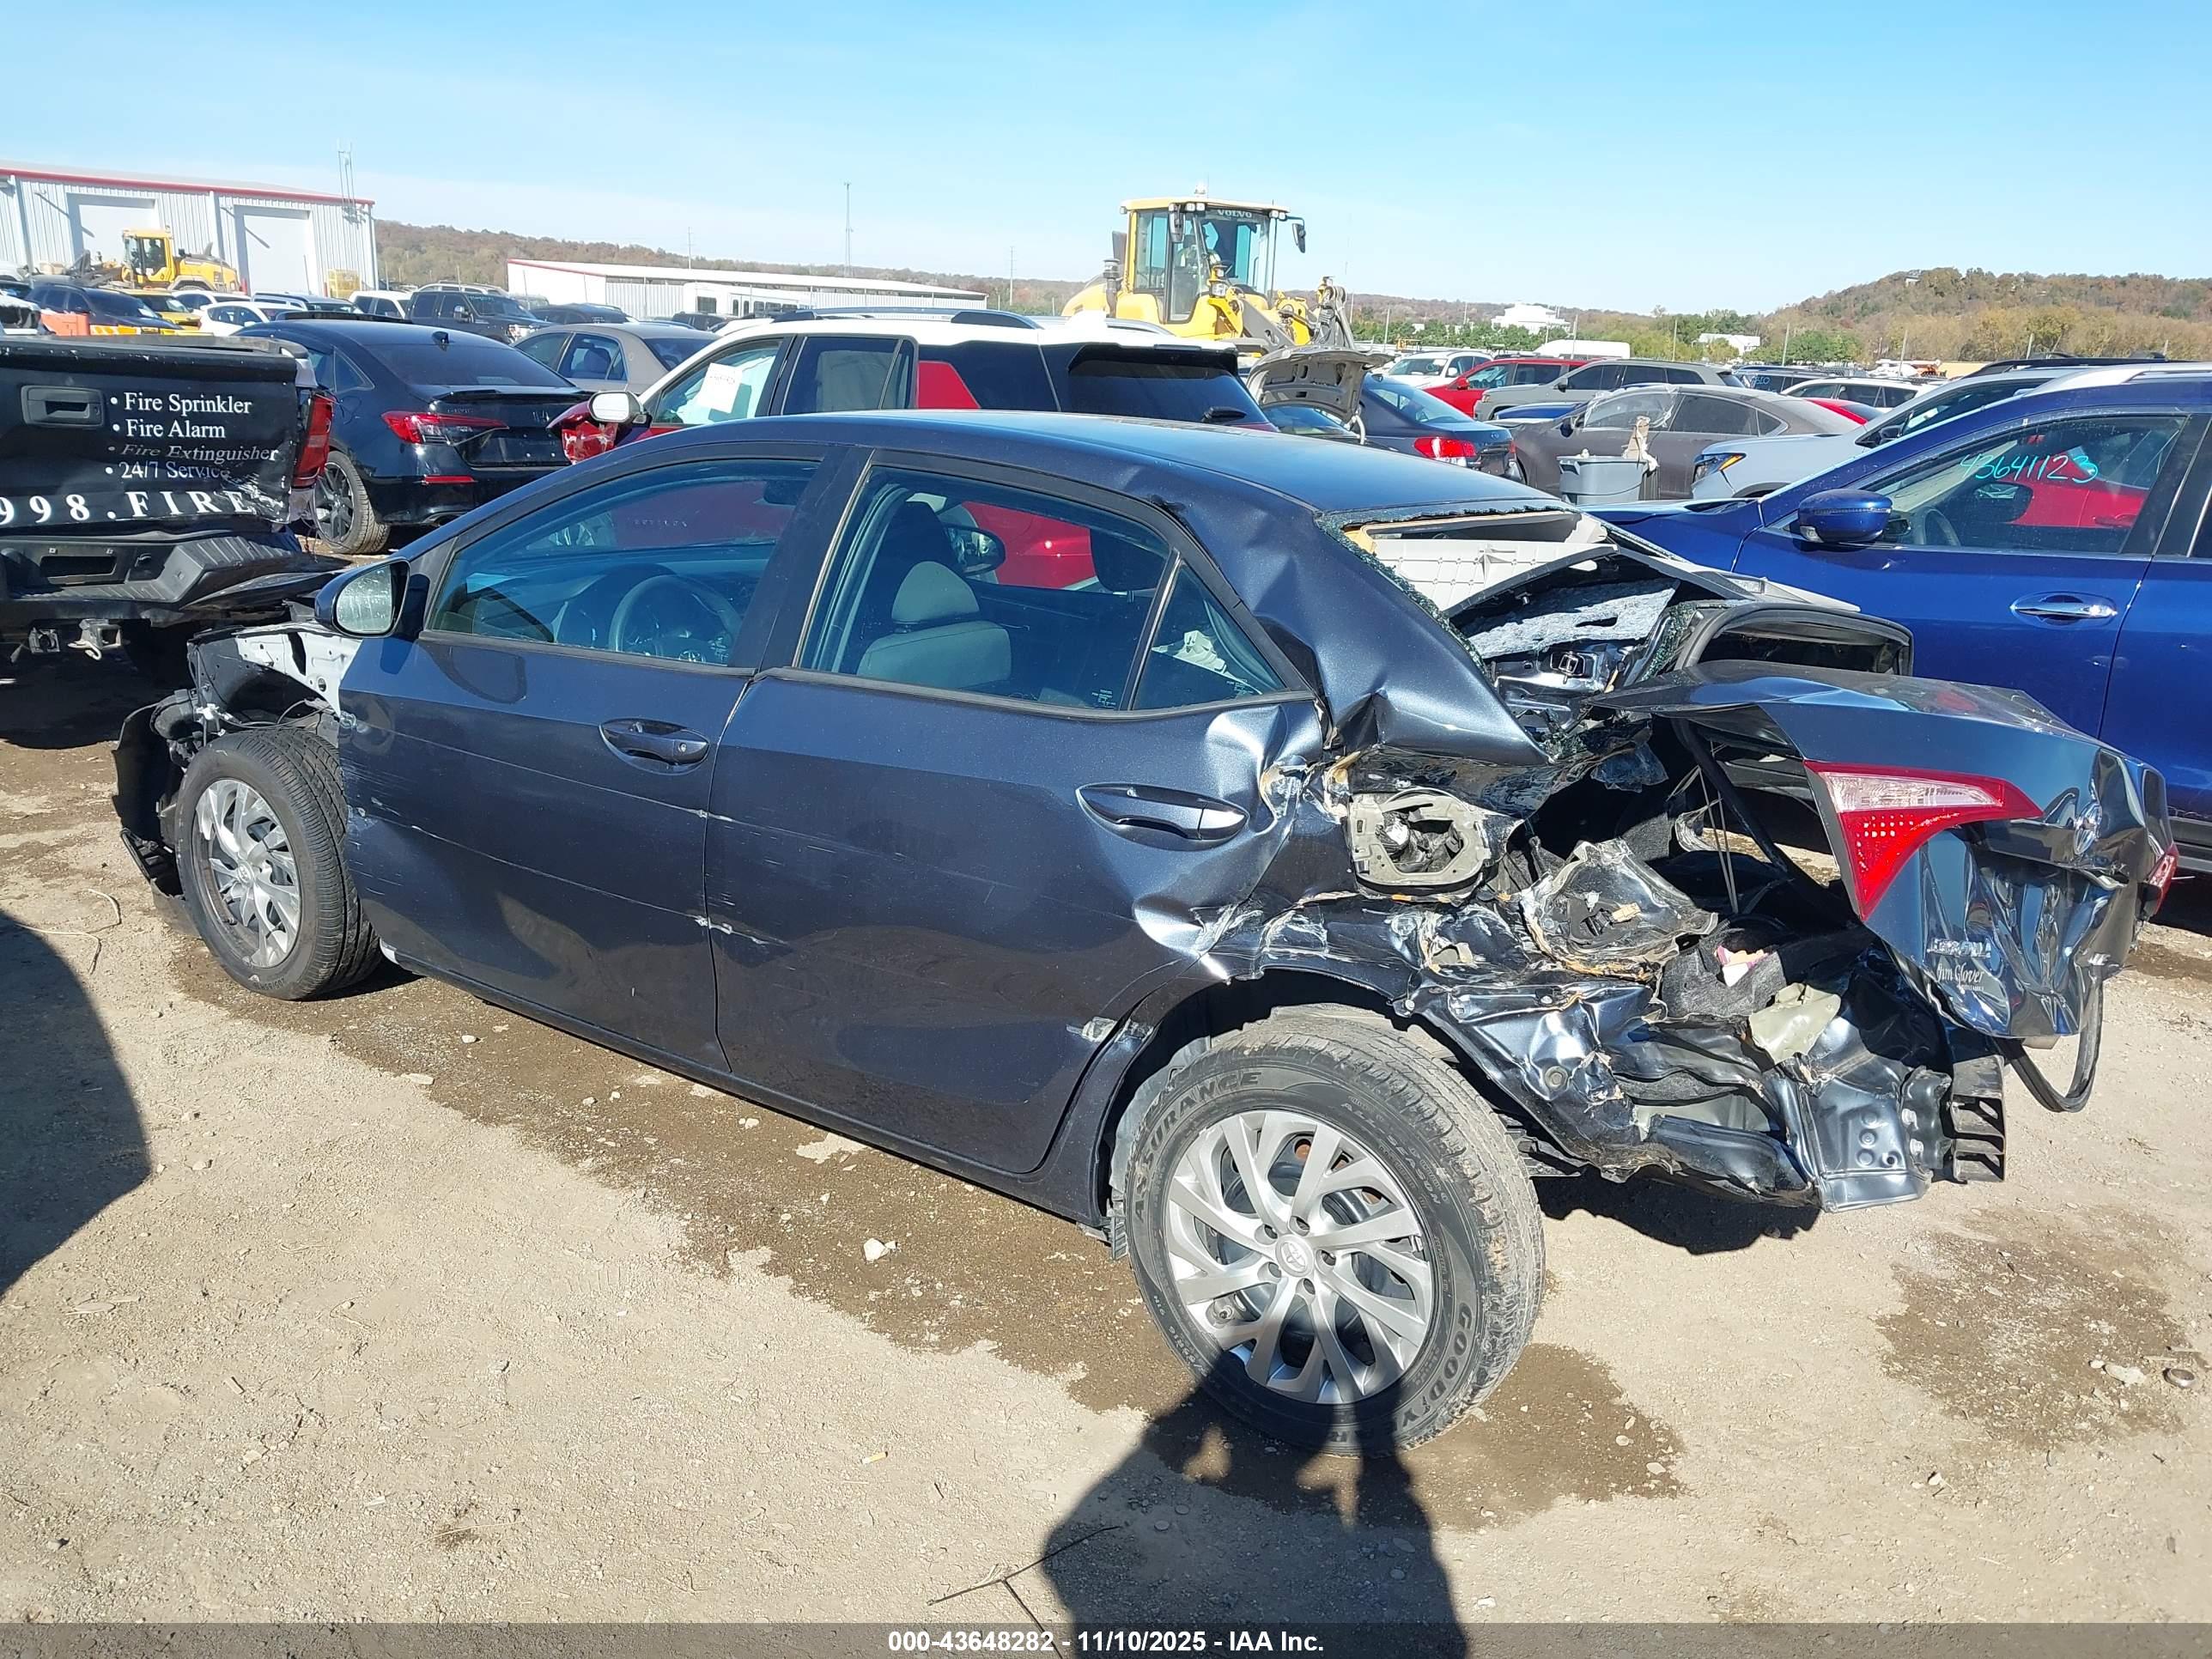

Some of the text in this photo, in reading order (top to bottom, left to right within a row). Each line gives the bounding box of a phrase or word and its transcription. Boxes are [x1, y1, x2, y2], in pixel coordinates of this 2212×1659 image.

[1217, 209, 1252, 218] VOLVO
[124, 392, 252, 416] Fire Sprinkler
[125, 419, 226, 439] Fire Alarm
[120, 444, 279, 465] Fire Extinguisher
[118, 461, 231, 478] 24/7 Service
[1960, 453, 2099, 483] 43641123
[1936, 962, 1984, 988] Jim Glover
[1329, 1301, 1474, 1444] GOODYR
